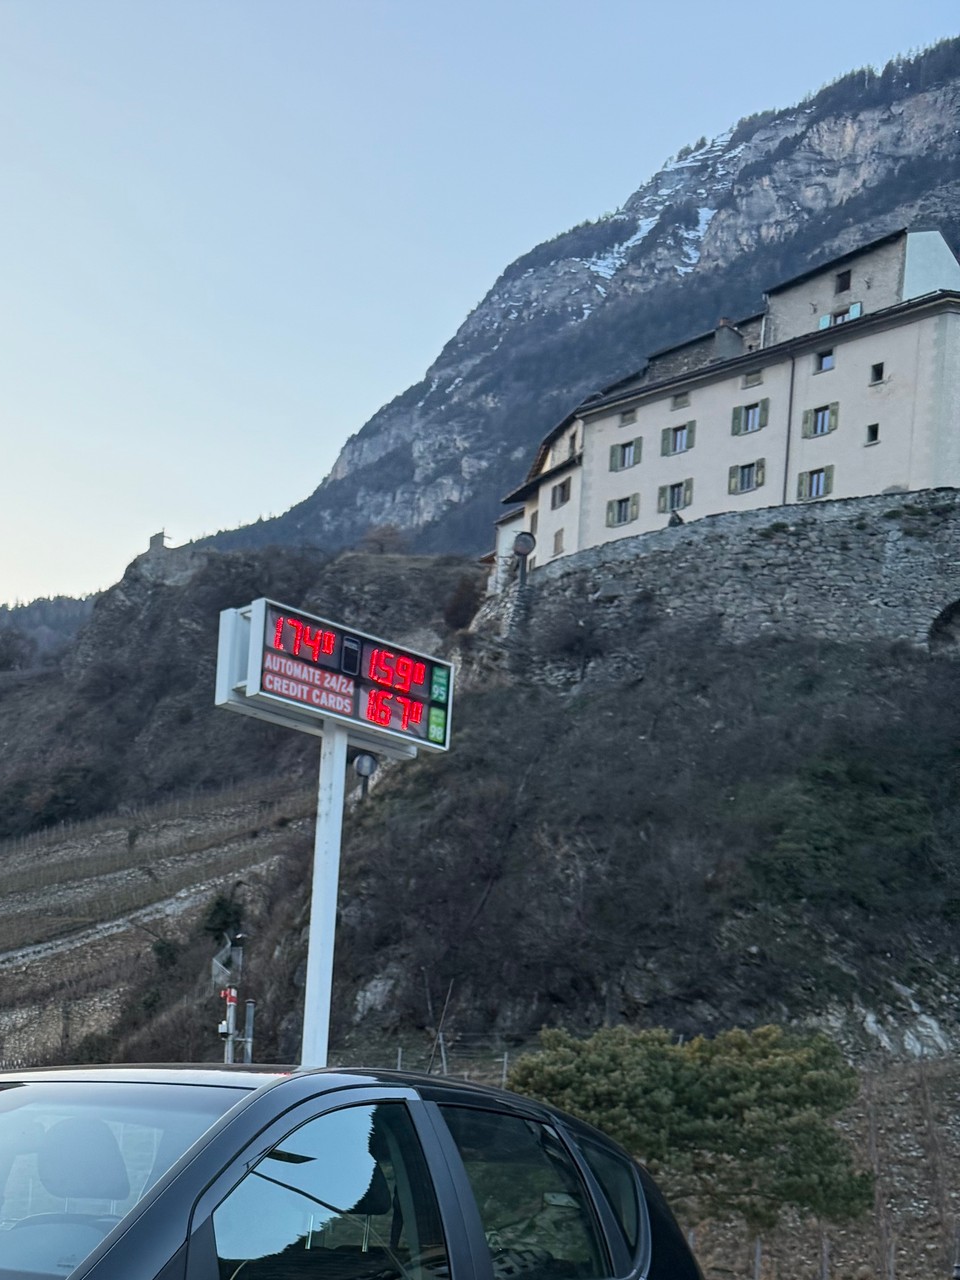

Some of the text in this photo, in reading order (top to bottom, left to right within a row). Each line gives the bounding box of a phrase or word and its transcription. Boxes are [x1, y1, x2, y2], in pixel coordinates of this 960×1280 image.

[265, 654, 355, 696] AUTOMATE 24/24
[265, 674, 352, 714] CREDIT CARDS
[431, 684, 446, 702] 95
[429, 724, 444, 741] 98
